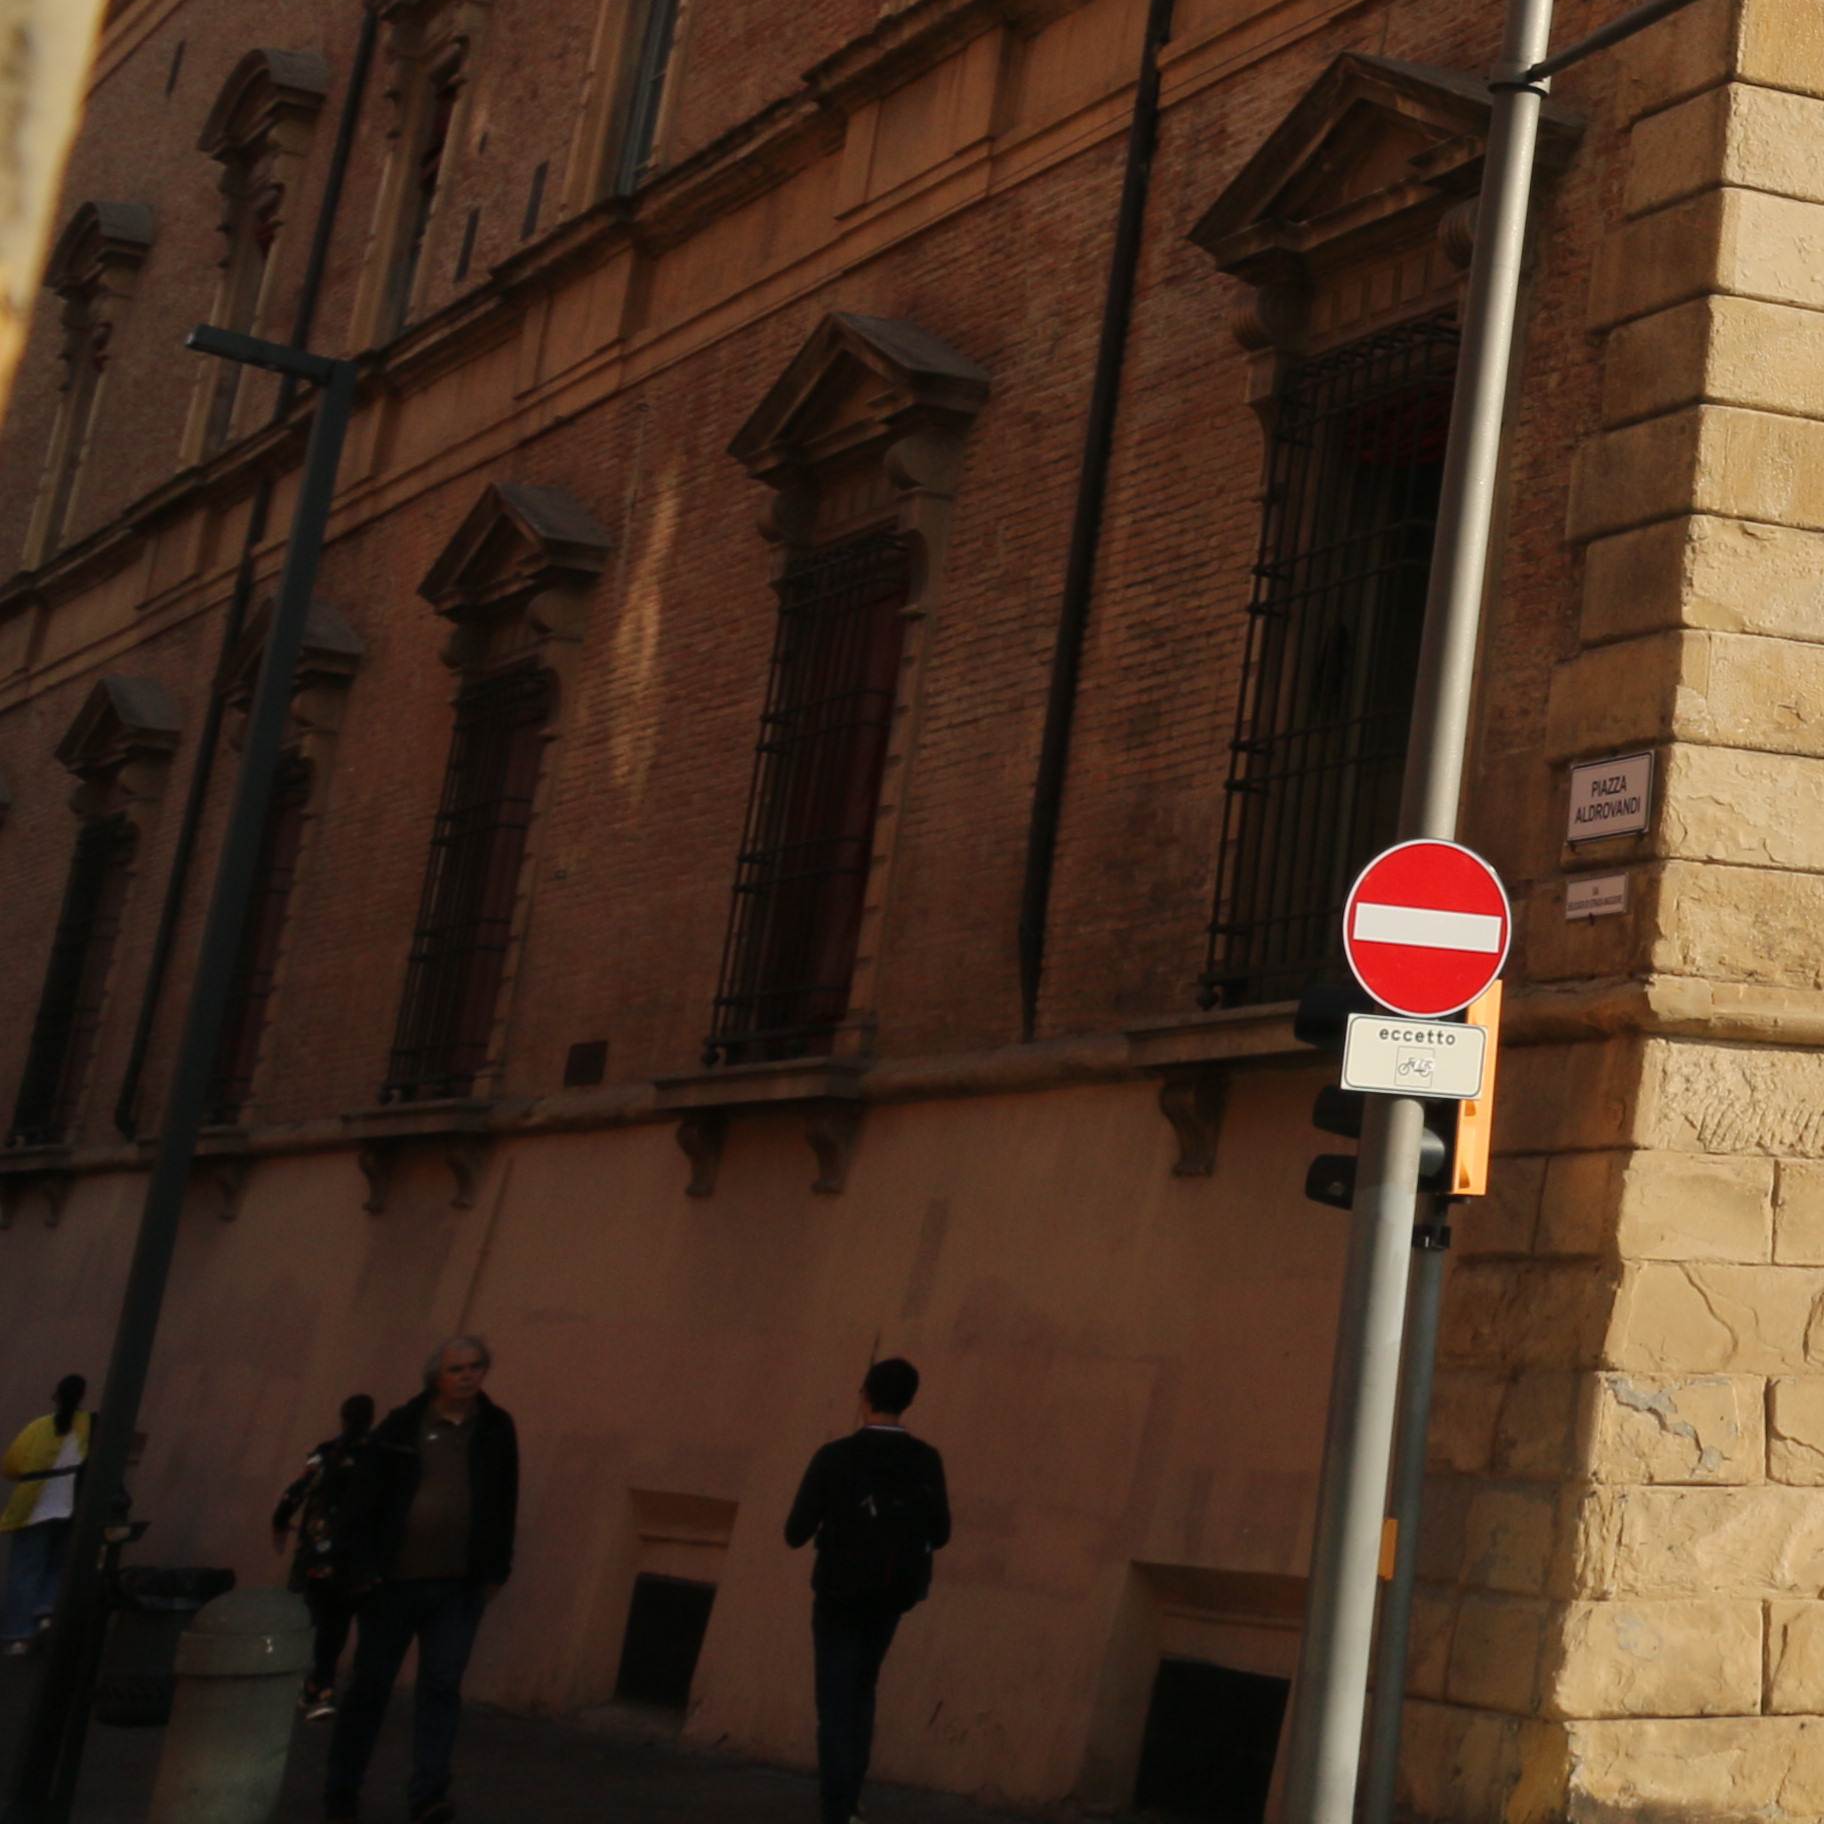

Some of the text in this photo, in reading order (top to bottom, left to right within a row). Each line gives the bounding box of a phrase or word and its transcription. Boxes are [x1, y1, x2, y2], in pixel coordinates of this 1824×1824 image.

[1591, 775, 1627, 797] PIAZZA
[1574, 796, 1641, 824] ALDROVANDI
[1379, 1028, 1456, 1046] eccetto
